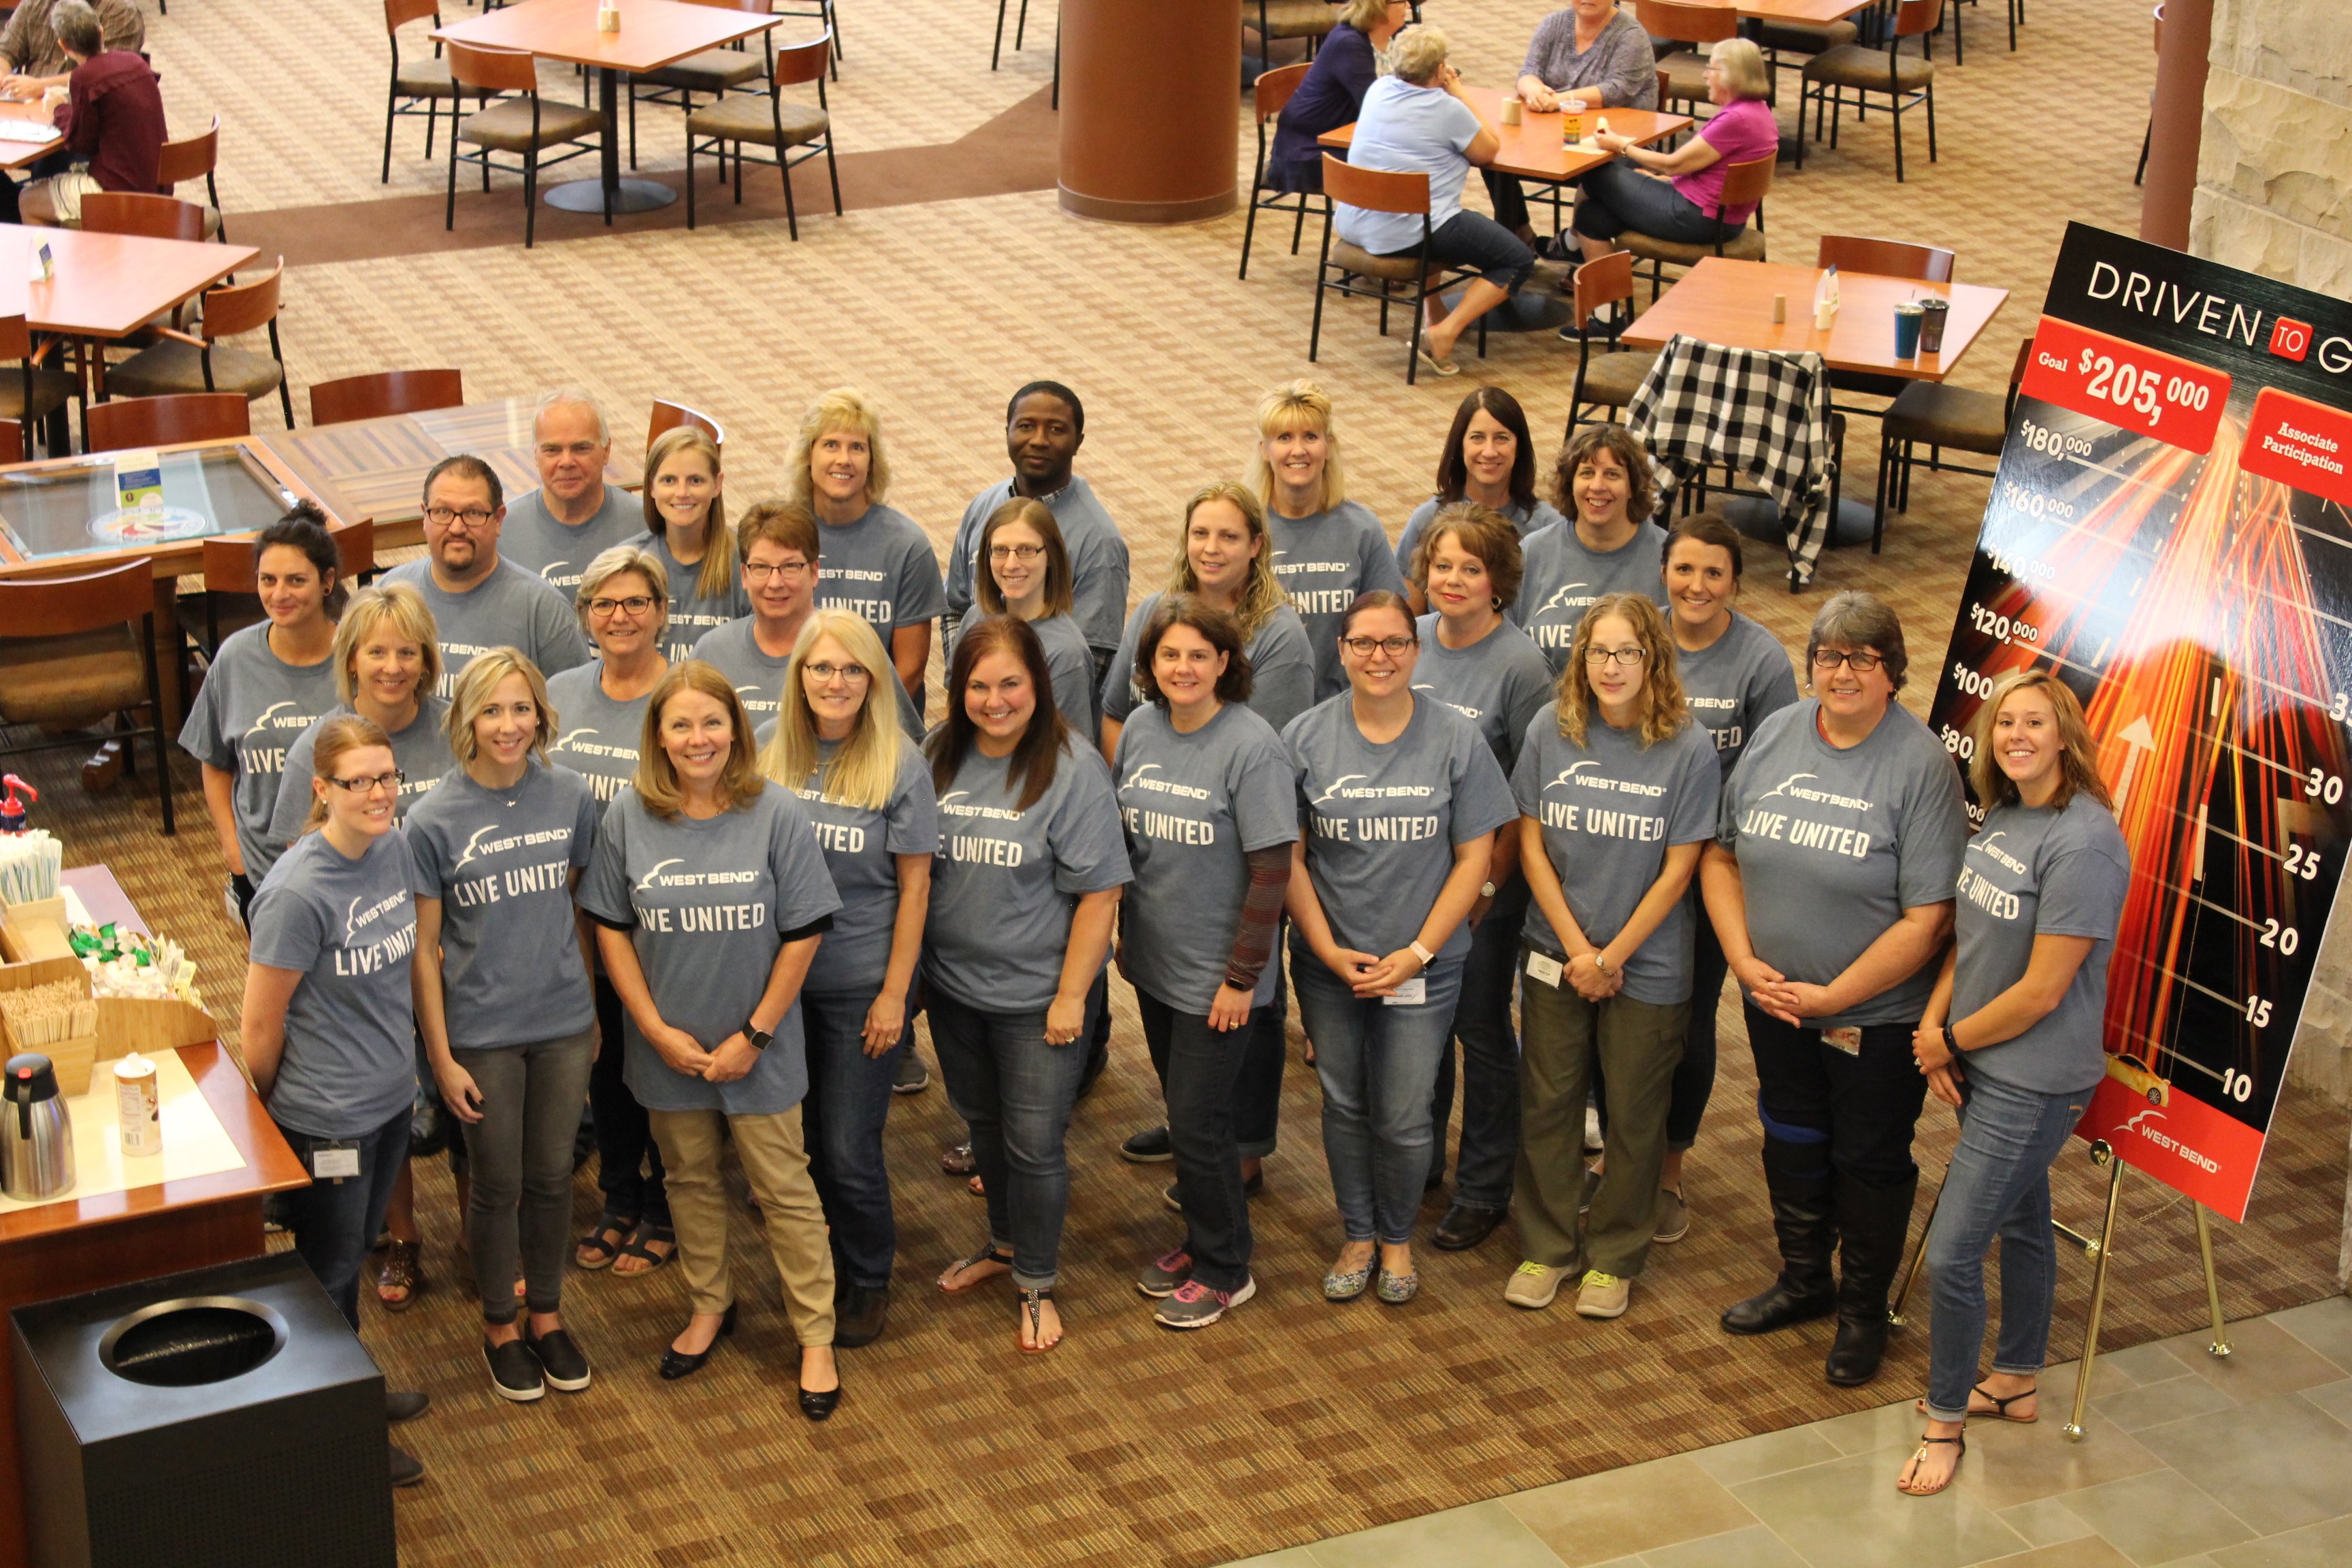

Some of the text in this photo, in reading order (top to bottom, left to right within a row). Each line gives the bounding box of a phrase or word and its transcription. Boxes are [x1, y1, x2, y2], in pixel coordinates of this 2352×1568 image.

[2087, 261, 2262, 346] DRIVEN
[2277, 326, 2304, 353] TO
[2038, 350, 2068, 373] Goal
[2277, 421, 2339, 453] Associate
[2261, 436, 2344, 475] Participation
[549, 575, 583, 587] WES
[818, 569, 883, 582] EST BEND
[1307, 562, 1346, 572] BEND
[1565, 597, 1597, 606] WES
[668, 614, 692, 625] EST
[1694, 698, 1735, 709] BEND
[2329, 692, 2352, 728] 3
[272, 716, 318, 728] WEST
[243, 748, 285, 774] LIVE
[572, 741, 640, 761] WEST BEN
[1139, 777, 1209, 800] WEST BEND
[1341, 785, 1430, 799] WEST BEND
[1575, 774, 1663, 797] WEST BEND
[1791, 785, 1869, 811] WEST BEND
[2304, 768, 2343, 806] 30
[944, 804, 982, 817] WEST
[1539, 800, 1665, 843] LIVE UNITED
[811, 821, 864, 853] ITED
[1120, 806, 1215, 846] VE UNITED
[1310, 815, 1438, 843] LIVE UNITED
[1742, 810, 1871, 858] LIVE UNITED
[479, 828, 568, 855] WEST BEND
[953, 836, 1023, 868] UNITED
[1985, 843, 2005, 860] WEST
[2283, 843, 2322, 881] 25
[454, 875, 501, 907] LIVE
[659, 871, 755, 887] WEST BEND
[1968, 874, 2020, 920] UNITED
[355, 902, 385, 928] WEST
[680, 902, 766, 932] UNITED
[335, 919, 417, 976] LIVE UNIT
[2259, 917, 2299, 956] 20
[2245, 994, 2273, 1028] 15
[2222, 1066, 2253, 1103] 10
[2142, 1124, 2218, 1175] WEST BEND
